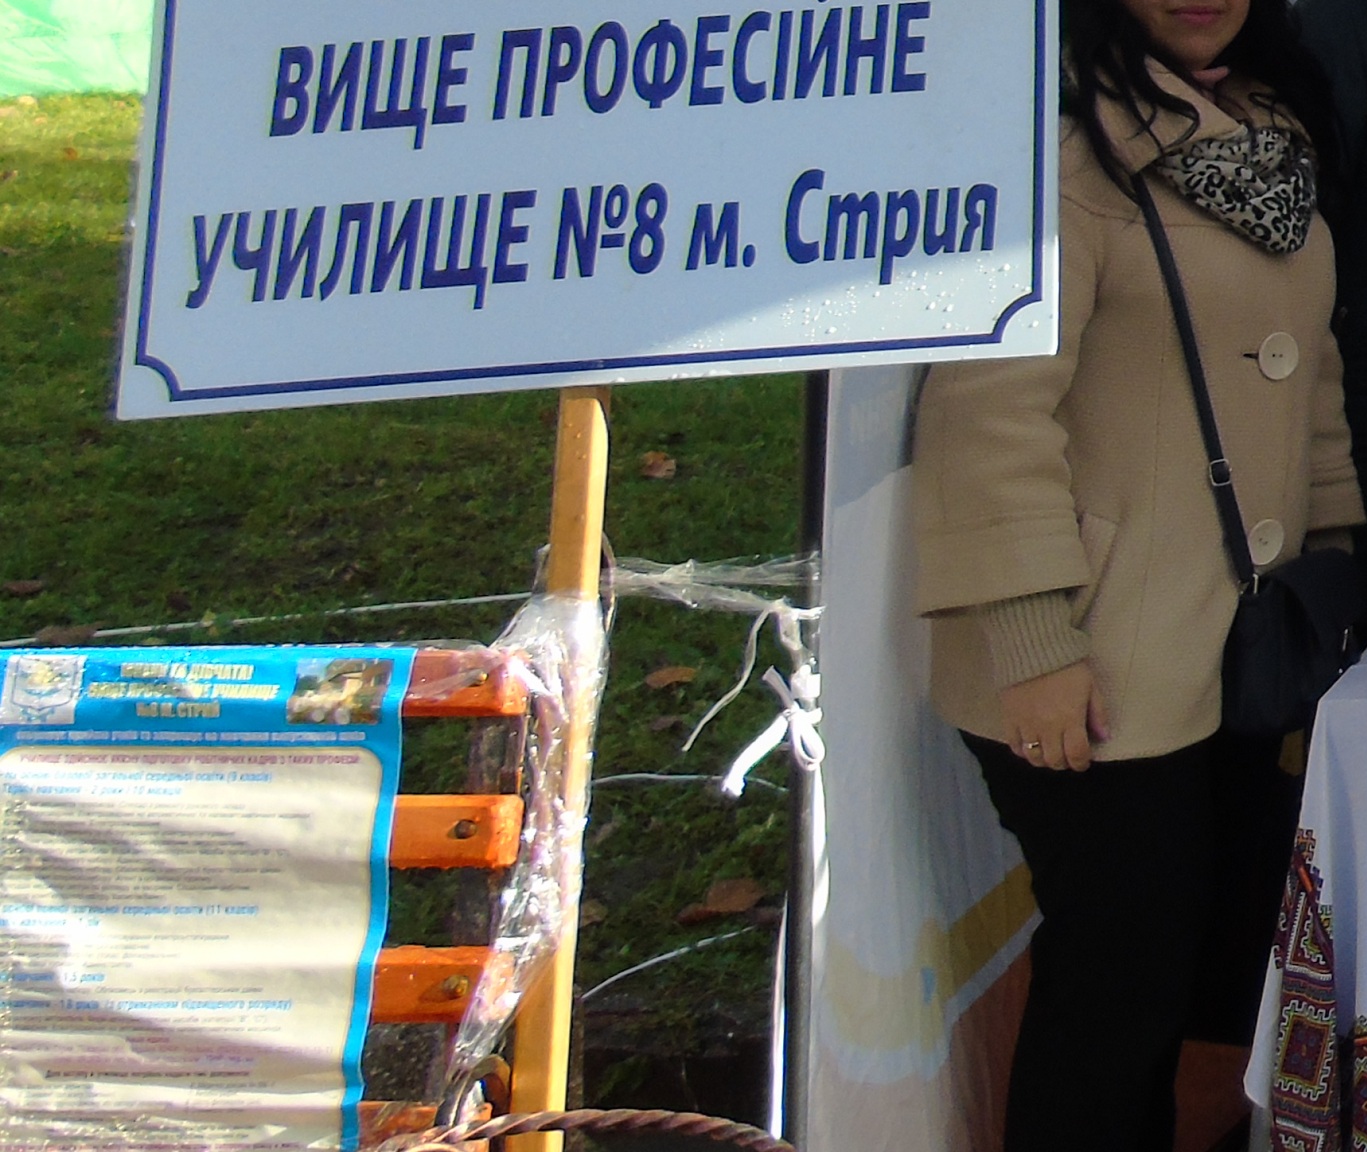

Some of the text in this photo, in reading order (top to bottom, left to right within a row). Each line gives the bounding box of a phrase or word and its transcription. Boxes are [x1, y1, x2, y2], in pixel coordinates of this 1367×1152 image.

[269, 32, 476, 150] ВИЩЕ
[185, 168, 998, 311] УЧИЛИЩЕ №8 м. Стрия
